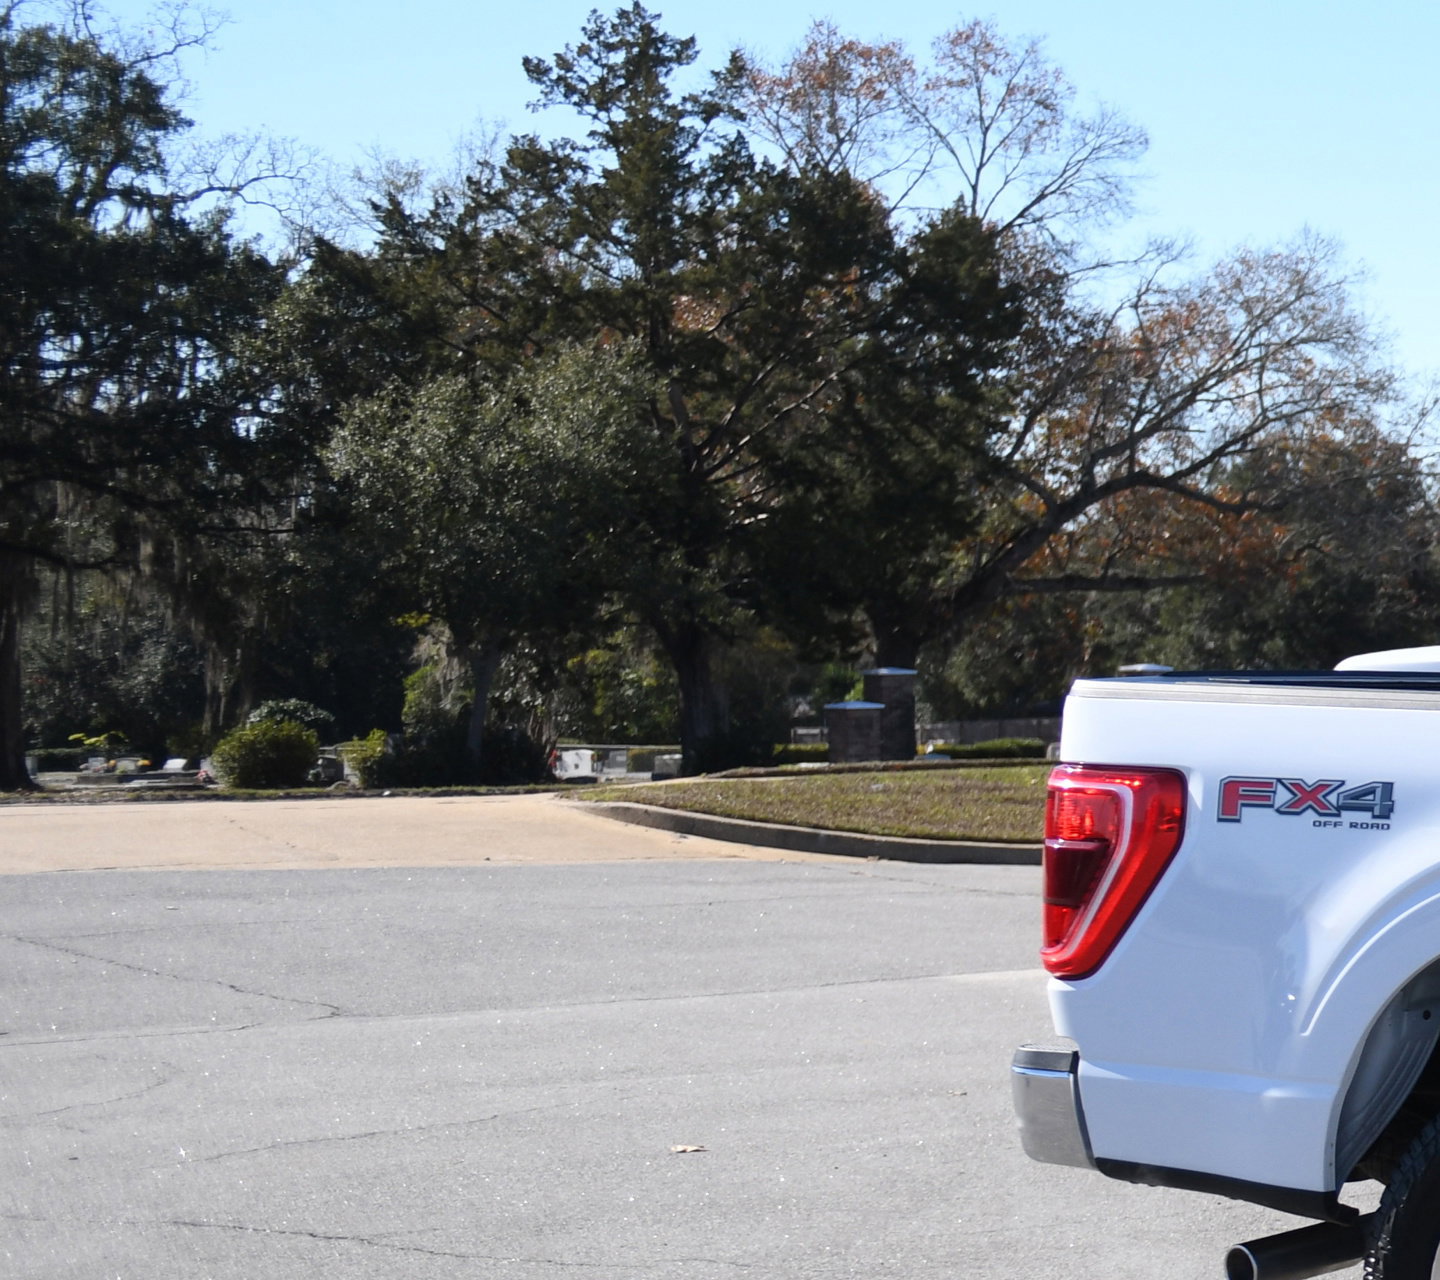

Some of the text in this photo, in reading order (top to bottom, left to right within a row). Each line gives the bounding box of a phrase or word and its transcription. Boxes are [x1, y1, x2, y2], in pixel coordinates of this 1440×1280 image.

[1217, 776, 1394, 823] FX4
[1312, 820, 1390, 831] OFF ROAD
